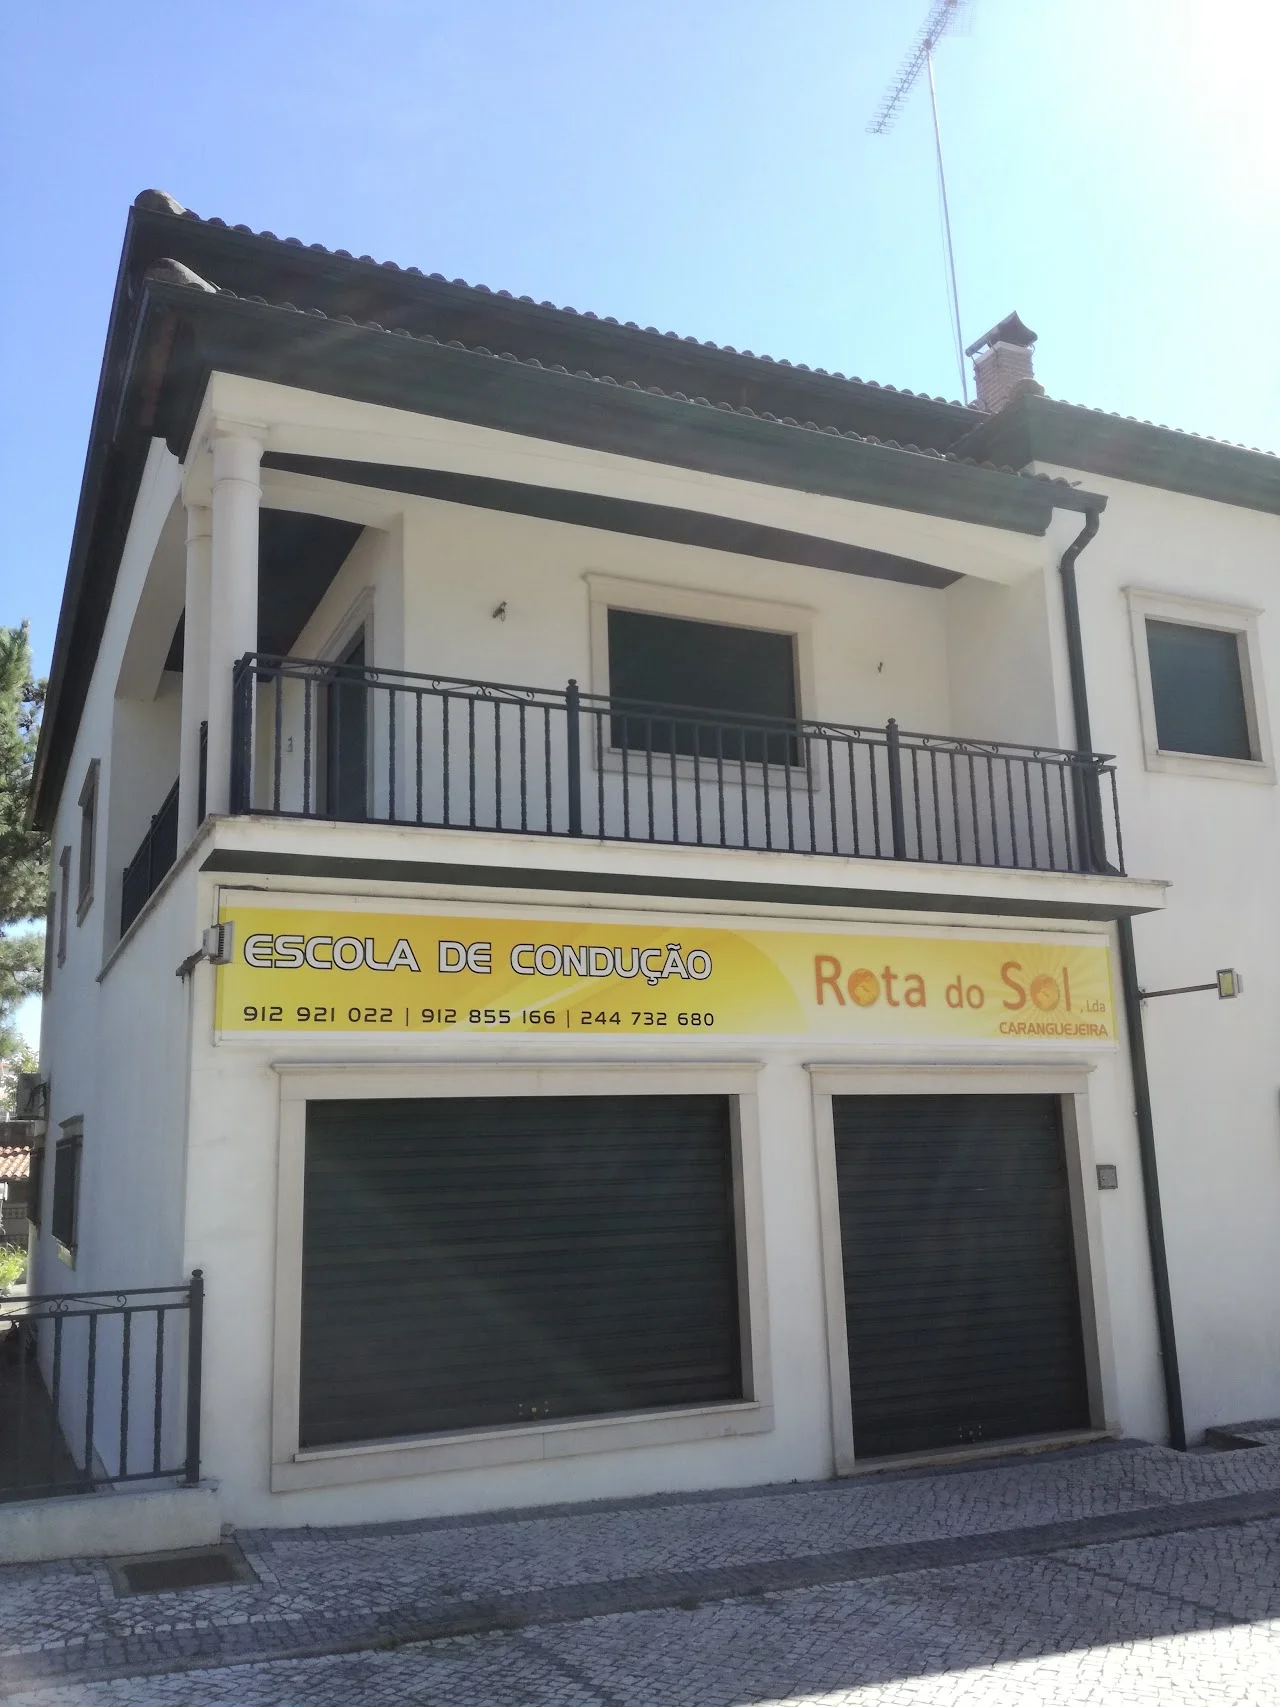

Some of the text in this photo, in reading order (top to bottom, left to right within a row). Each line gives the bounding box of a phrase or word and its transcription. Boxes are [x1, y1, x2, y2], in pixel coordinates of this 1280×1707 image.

[243, 934, 713, 986] ESCOLA DE CONDUÇÃO
[814, 955, 926, 1007] Rota
[945, 975, 985, 1009] do
[1001, 961, 1072, 1012] Sol
[243, 1006, 283, 1022] 912
[297, 1007, 335, 1022] 921
[348, 1007, 393, 1023] 022
[421, 1008, 457, 1023] 912
[469, 1009, 511, 1024] 855
[522, 1010, 556, 1024] 166
[581, 1011, 621, 1025] 244
[631, 1012, 667, 1026] 732
[677, 1012, 714, 1026] 680
[999, 1021, 1108, 1036] CARANGUEJEIRA
